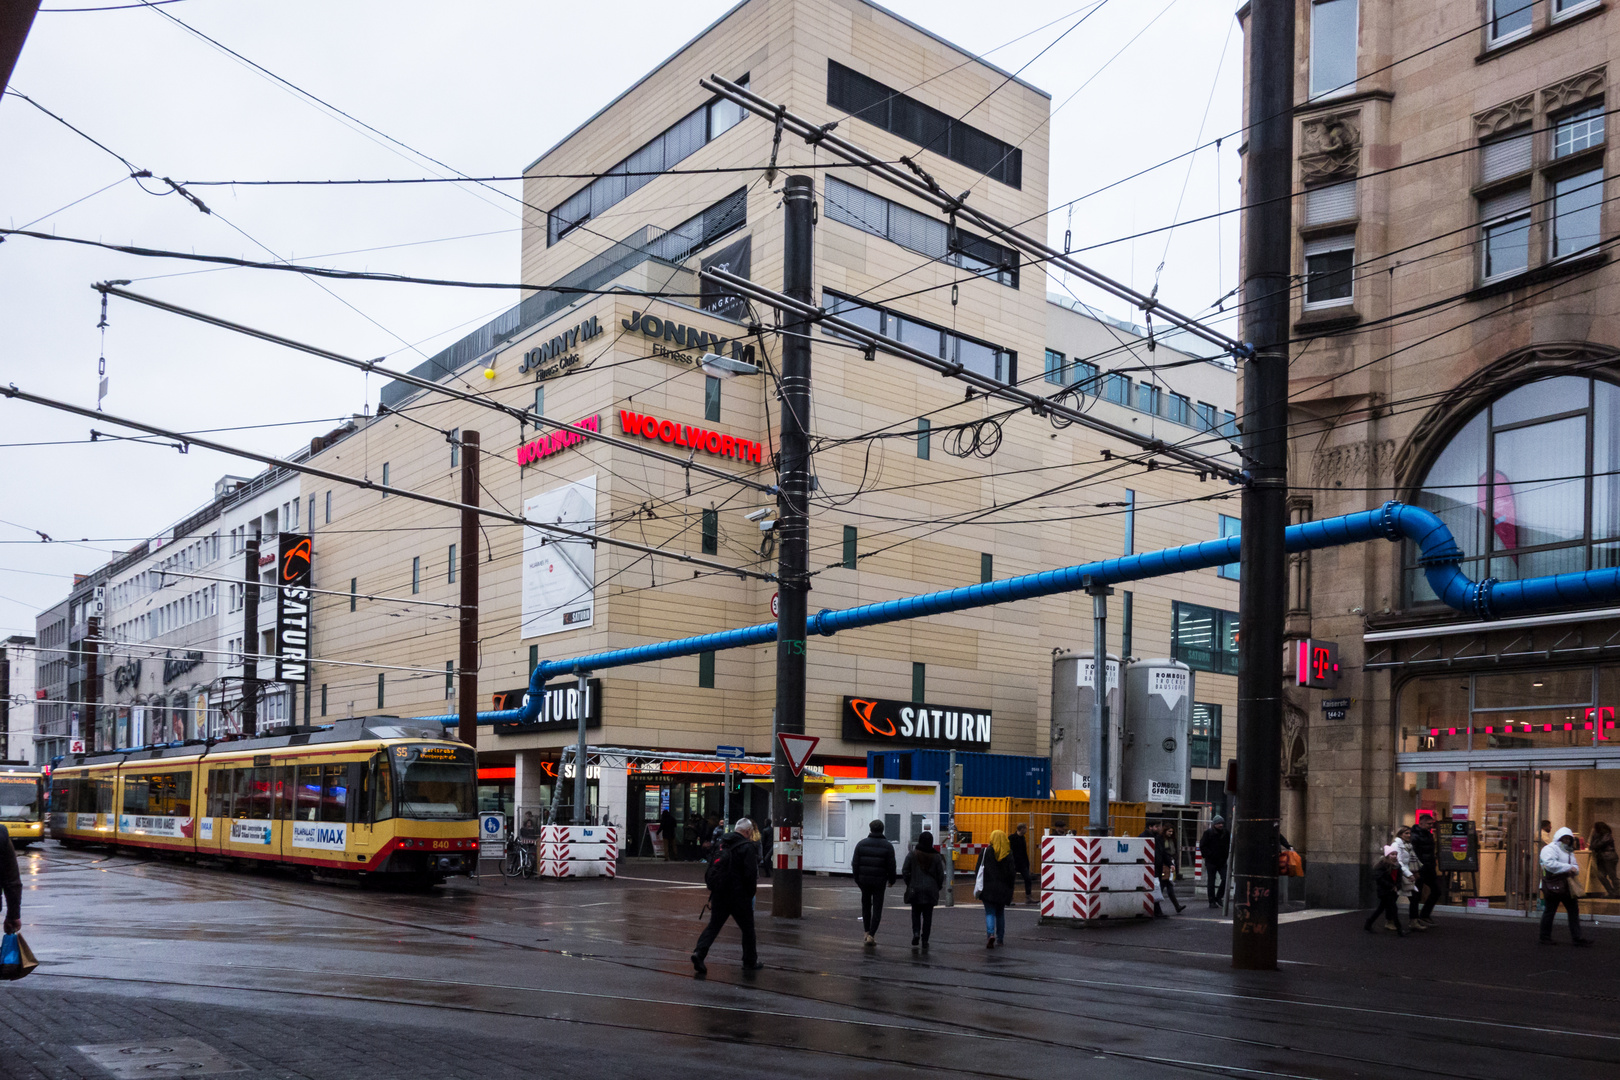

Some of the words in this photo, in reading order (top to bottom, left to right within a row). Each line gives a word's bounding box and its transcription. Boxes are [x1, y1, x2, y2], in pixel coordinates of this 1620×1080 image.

[621, 310, 727, 355] JONNY
[518, 323, 580, 374] JONNY
[652, 343, 693, 365] Fitness
[535, 363, 559, 382] Fitness
[559, 353, 580, 370] Clubs
[517, 414, 600, 466] WOOLWORTH
[620, 410, 762, 463] WOOLWORTH
[572, 608, 590, 622] SATURN
[282, 585, 308, 681] SATURN
[1155, 672, 1186, 680] ROMBOLD
[900, 707, 991, 743] SATURN
[396, 747, 408, 758] S5
[317, 828, 344, 845] IMAX
[432, 841, 449, 849] 840
